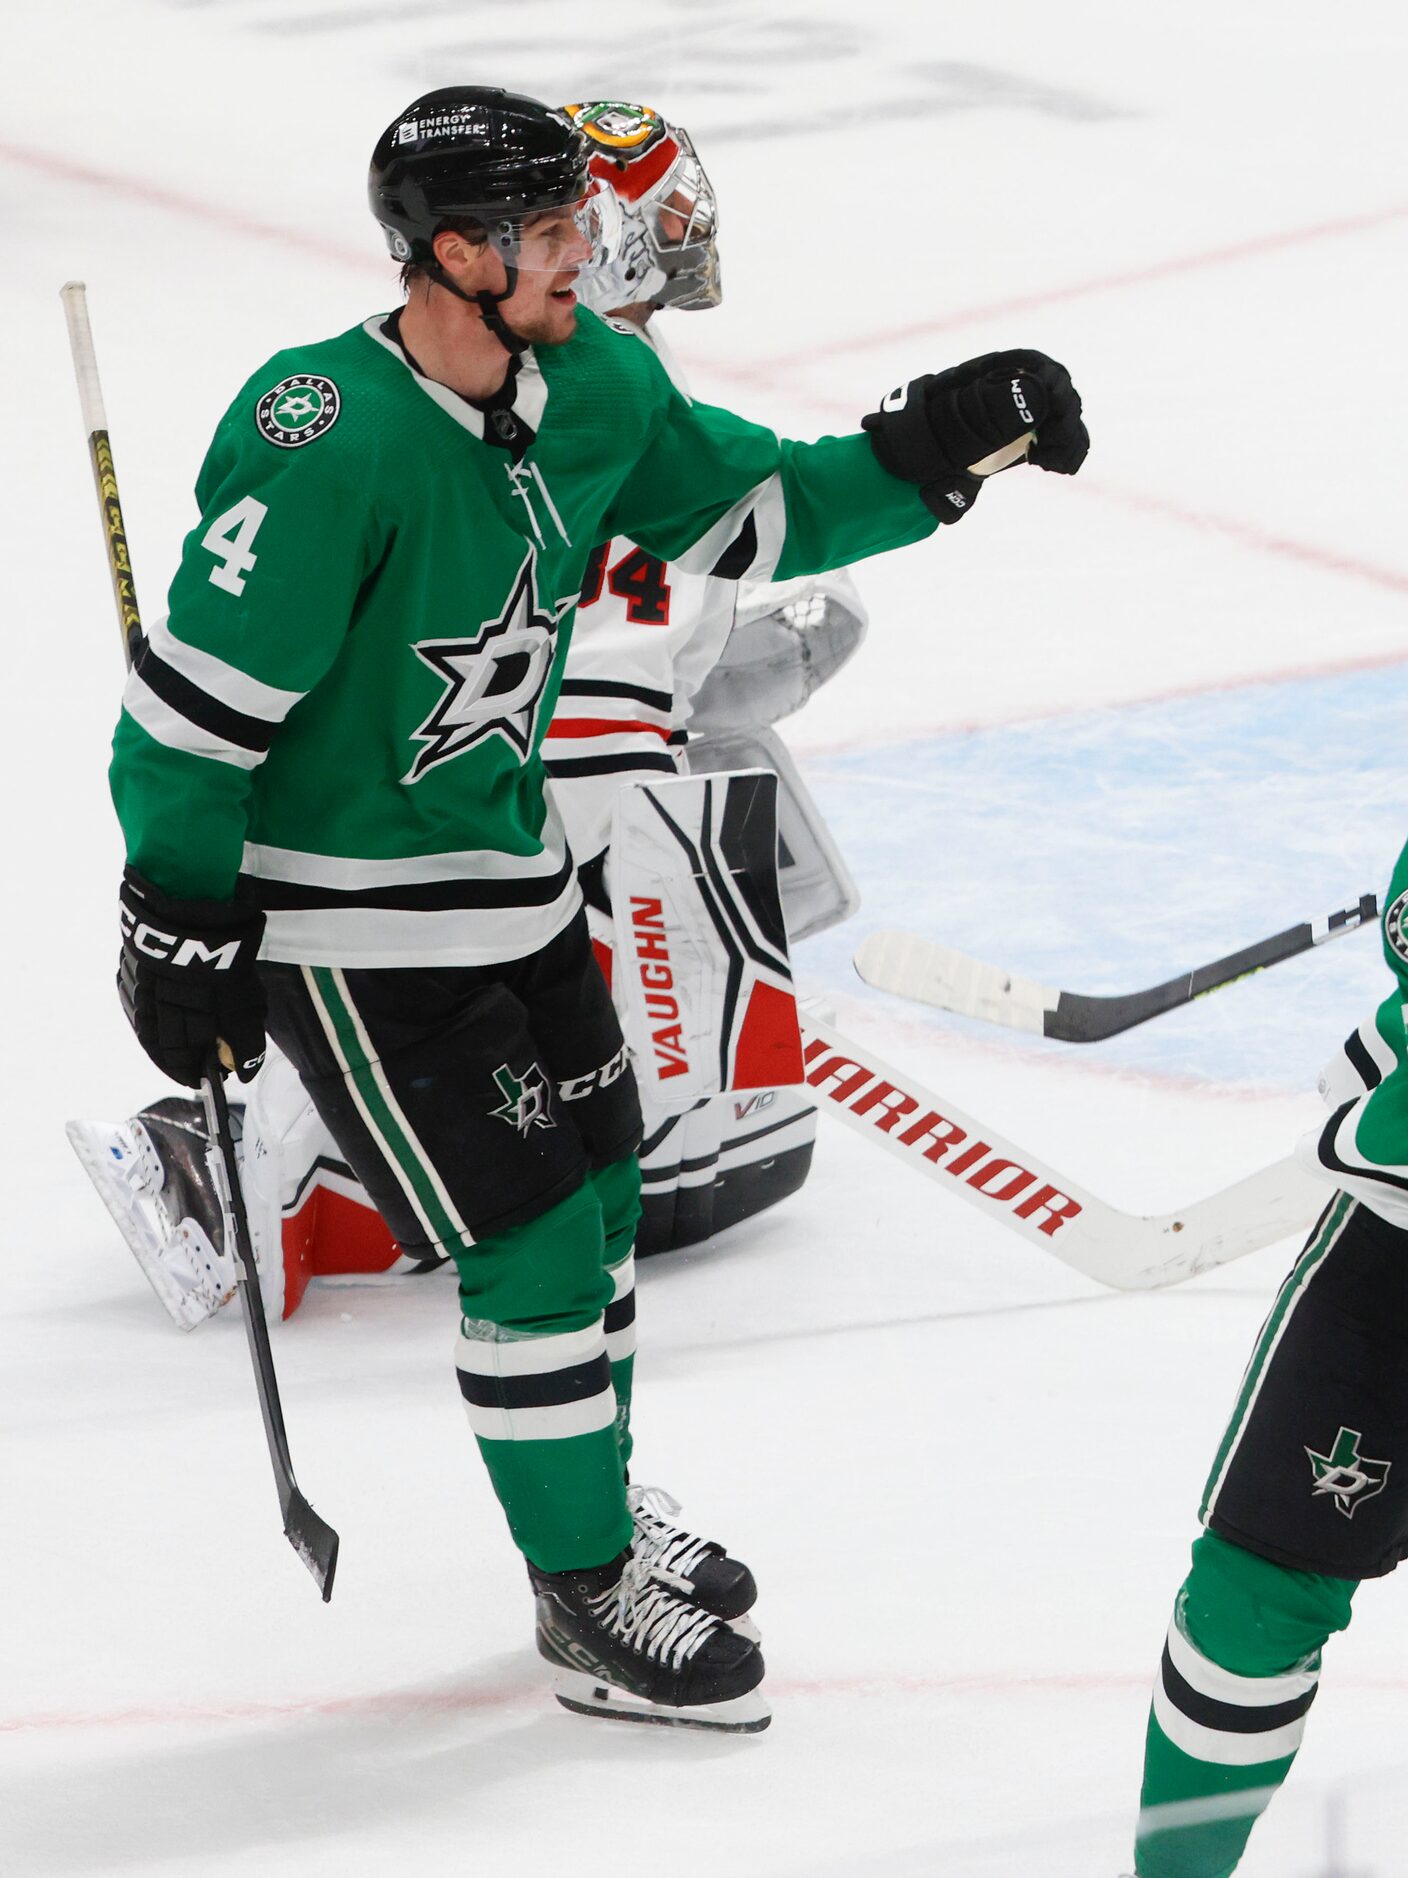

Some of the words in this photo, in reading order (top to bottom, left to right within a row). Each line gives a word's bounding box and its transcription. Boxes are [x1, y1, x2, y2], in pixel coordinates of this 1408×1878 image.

[419, 115, 467, 129] ENERGY
[419, 126, 482, 138] TRANSFER
[275, 378, 334, 414] DALLAS
[1010, 378, 1034, 424] CCM
[261, 409, 315, 442] STARS
[201, 495, 268, 597] 4
[118, 899, 242, 970] CCM
[630, 896, 690, 1081] VAUGHN
[734, 1091, 776, 1121] V10
